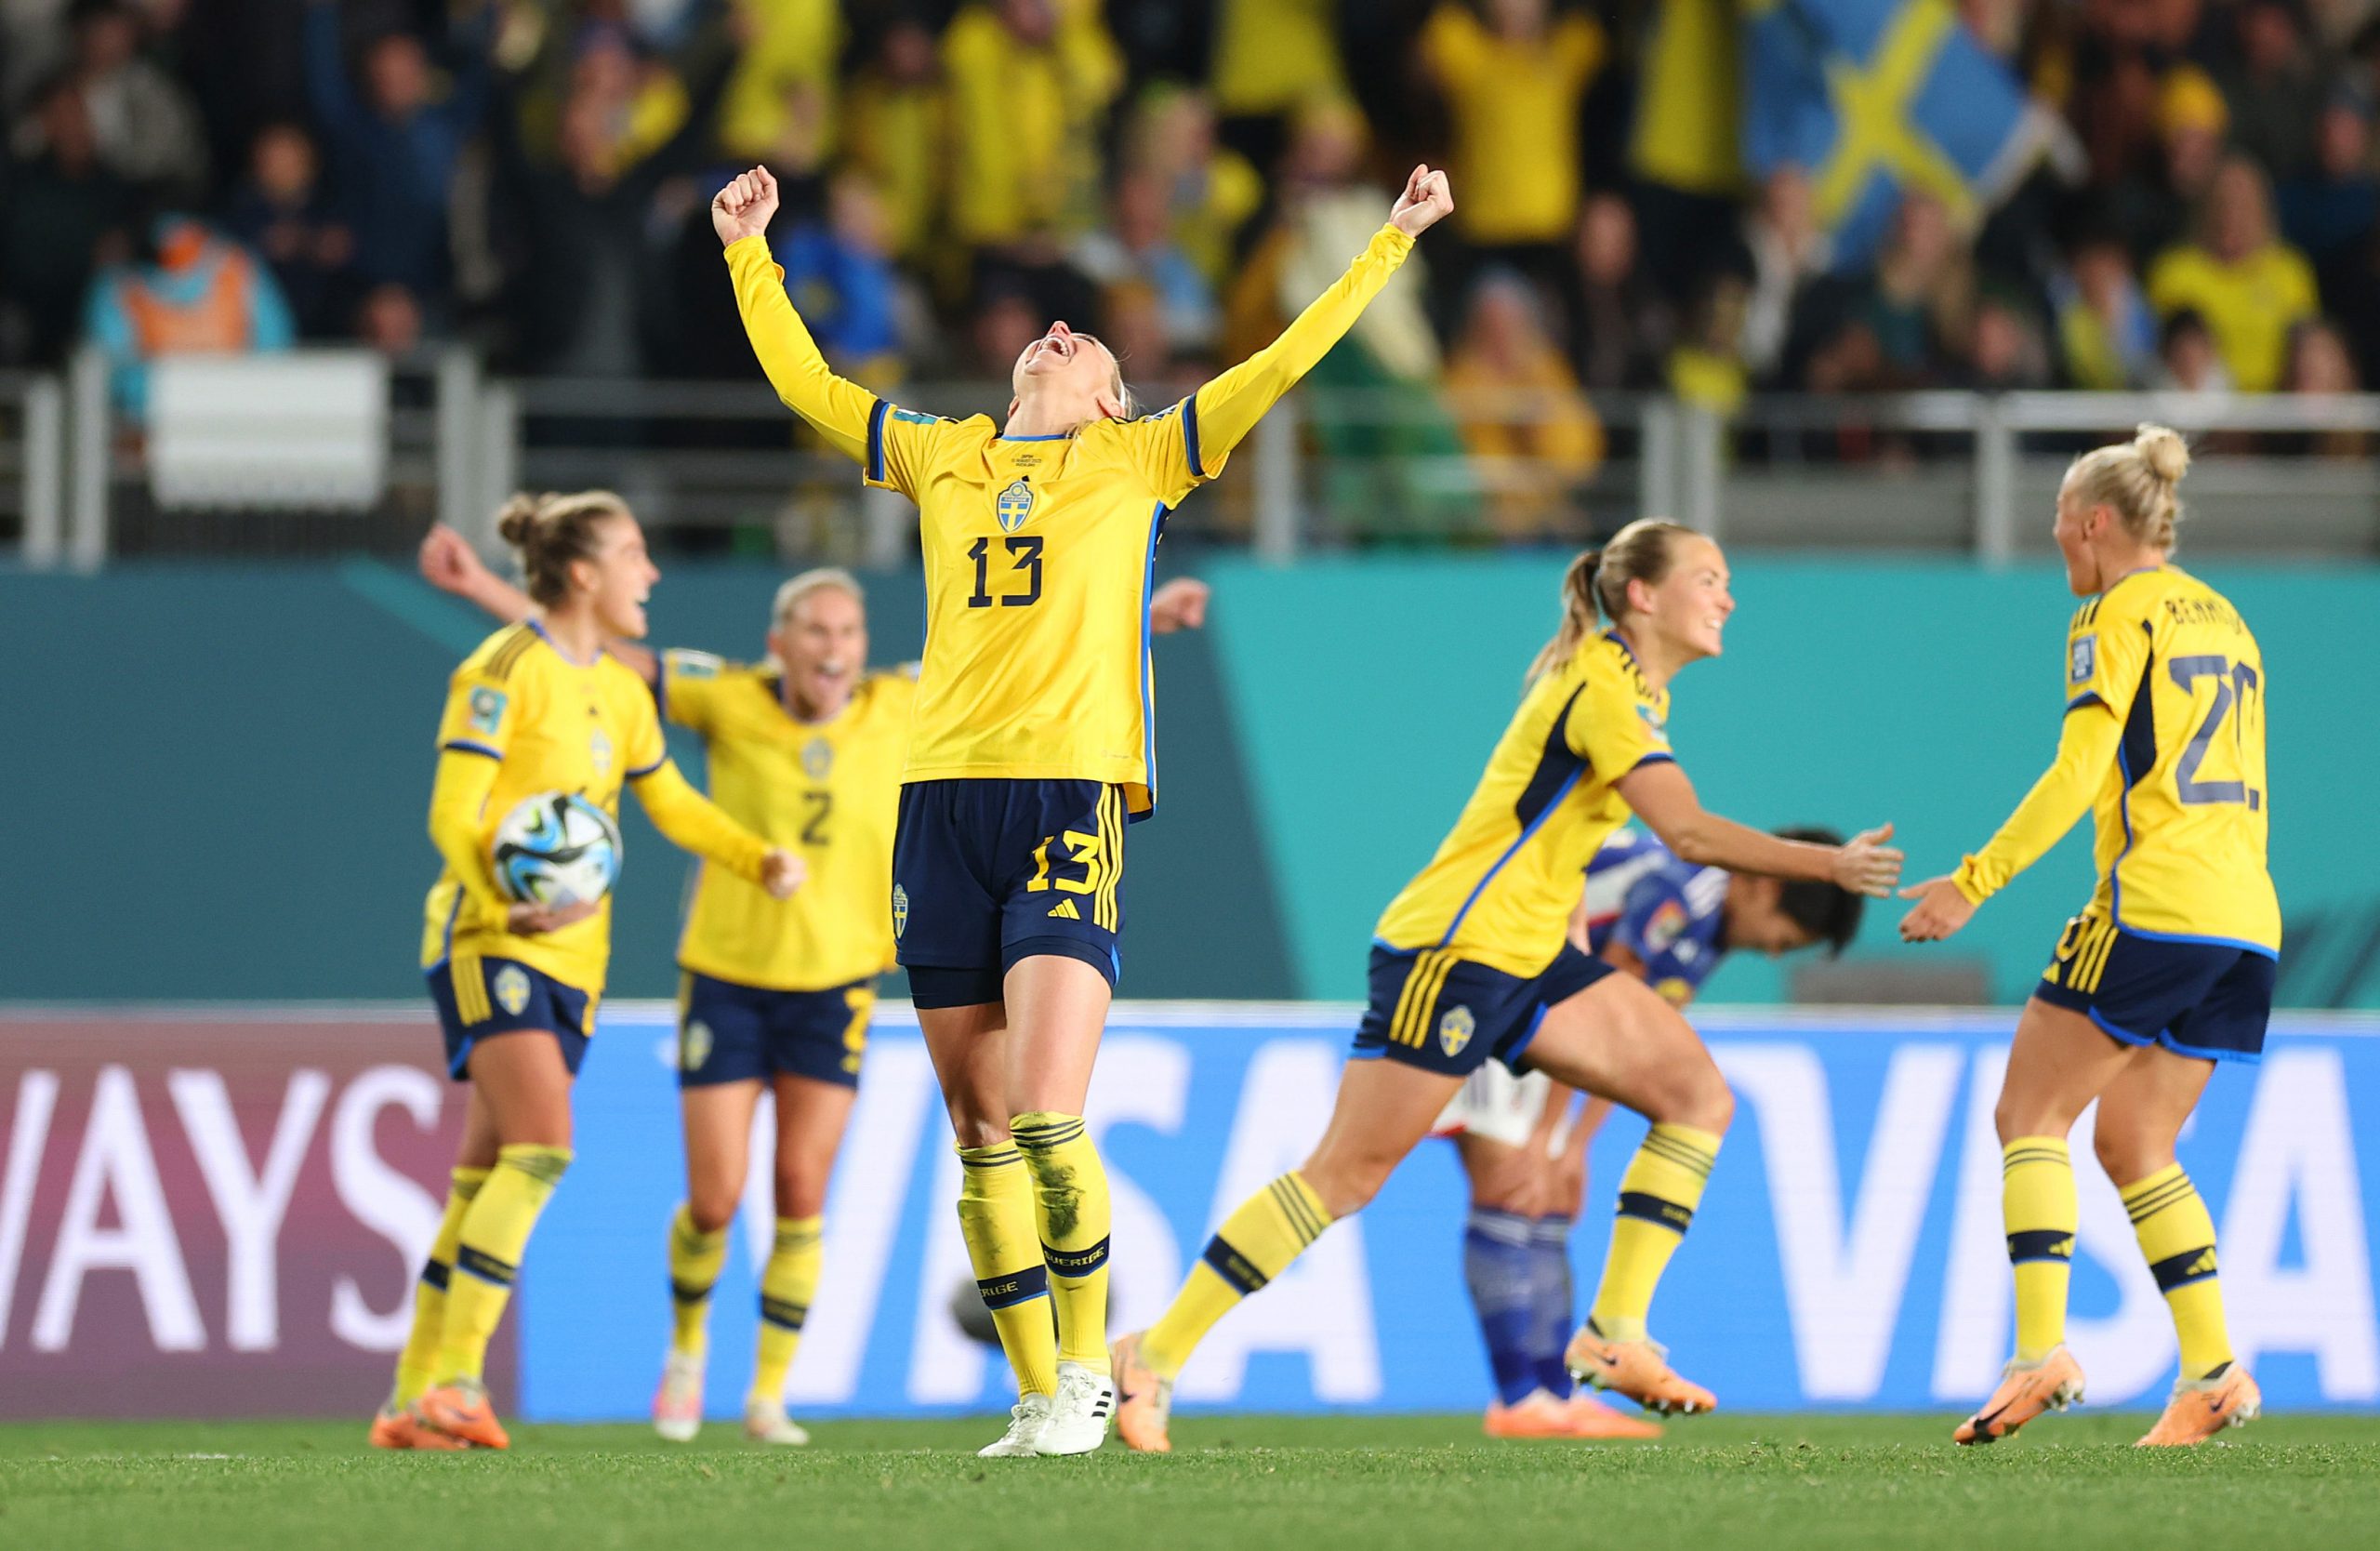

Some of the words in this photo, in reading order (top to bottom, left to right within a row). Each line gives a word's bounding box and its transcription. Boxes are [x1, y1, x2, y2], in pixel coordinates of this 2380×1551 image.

[968, 537, 1044, 608] 13
[800, 790, 833, 846] 2
[1026, 830, 1102, 895] 13
[980, 1280, 1019, 1298] RIGE
